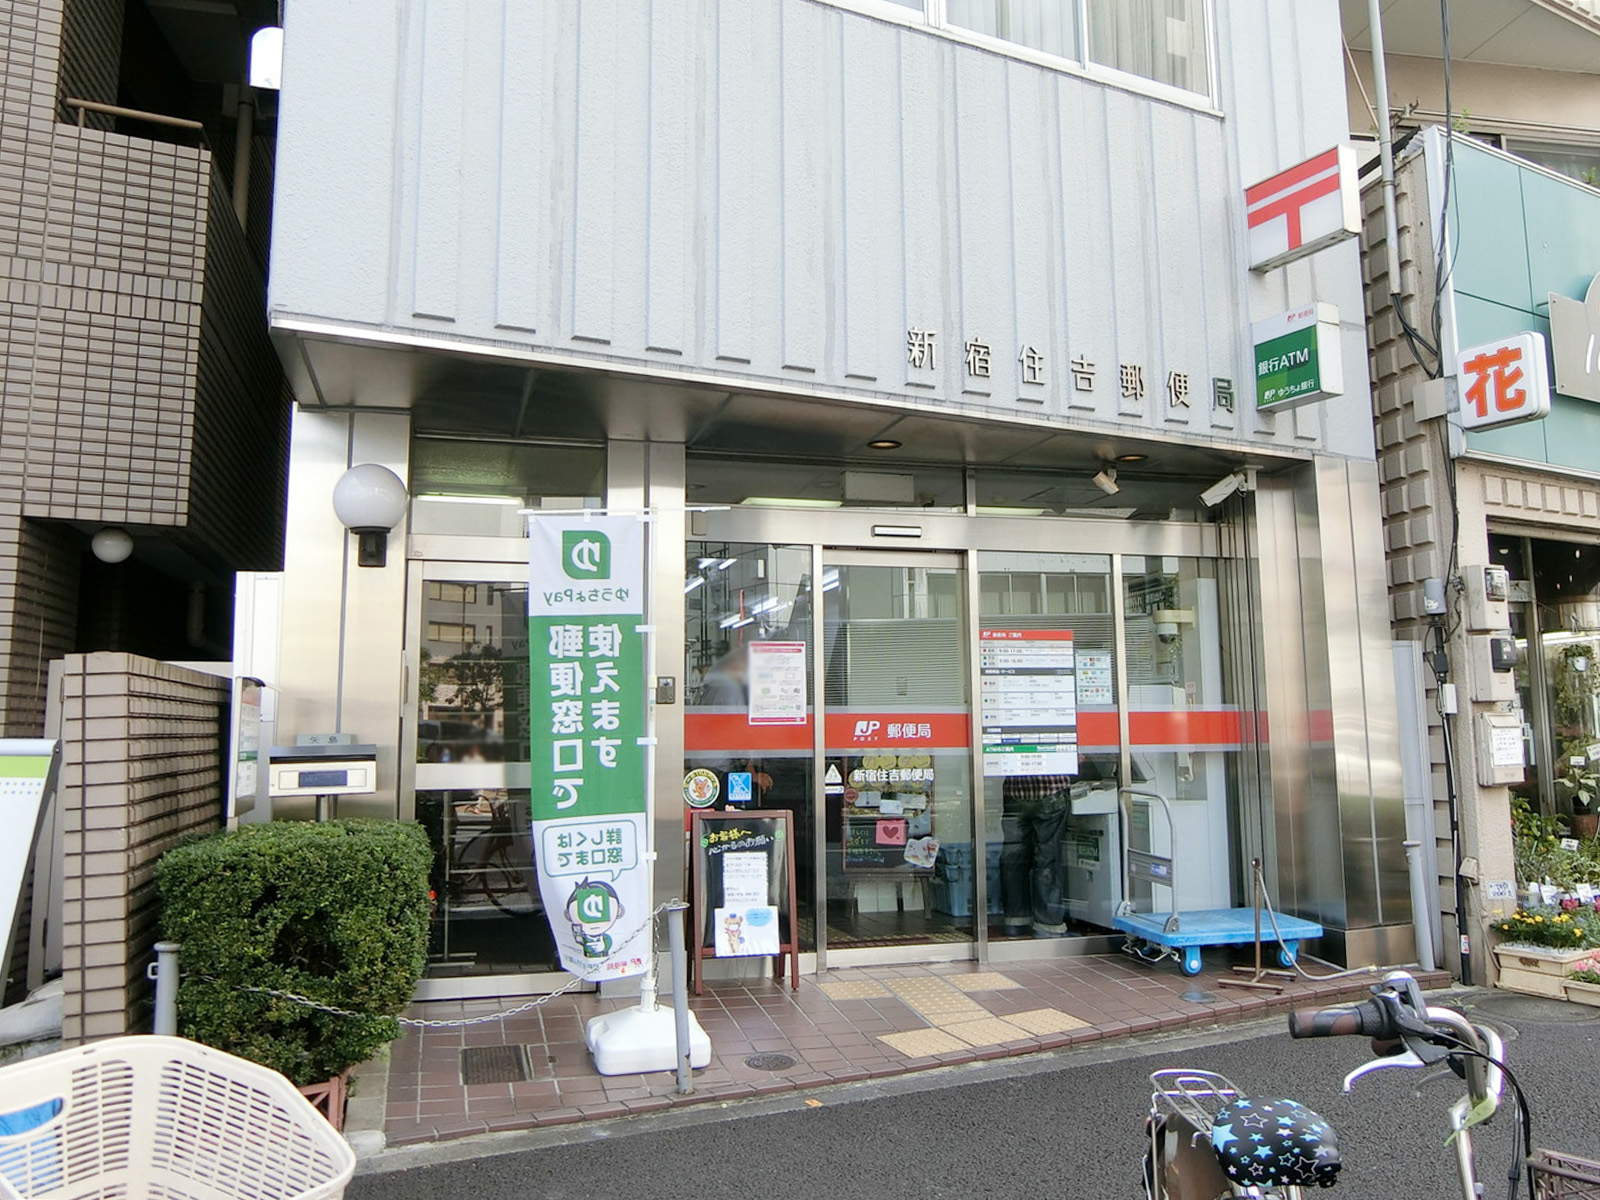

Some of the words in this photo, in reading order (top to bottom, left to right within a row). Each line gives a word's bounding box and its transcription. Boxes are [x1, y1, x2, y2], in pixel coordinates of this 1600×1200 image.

[907, 326, 1234, 413] 新宿住吉郵便局
[1258, 347, 1309, 376] 銀行ATM
[1277, 379, 1315, 397] ゆうちょ銀行
[1463, 346, 1526, 418] 花
[887, 722, 932, 739] 郵便局
[853, 768, 934, 782] 新宿住吉郵便局
[708, 834, 774, 856] 心からのお願い
